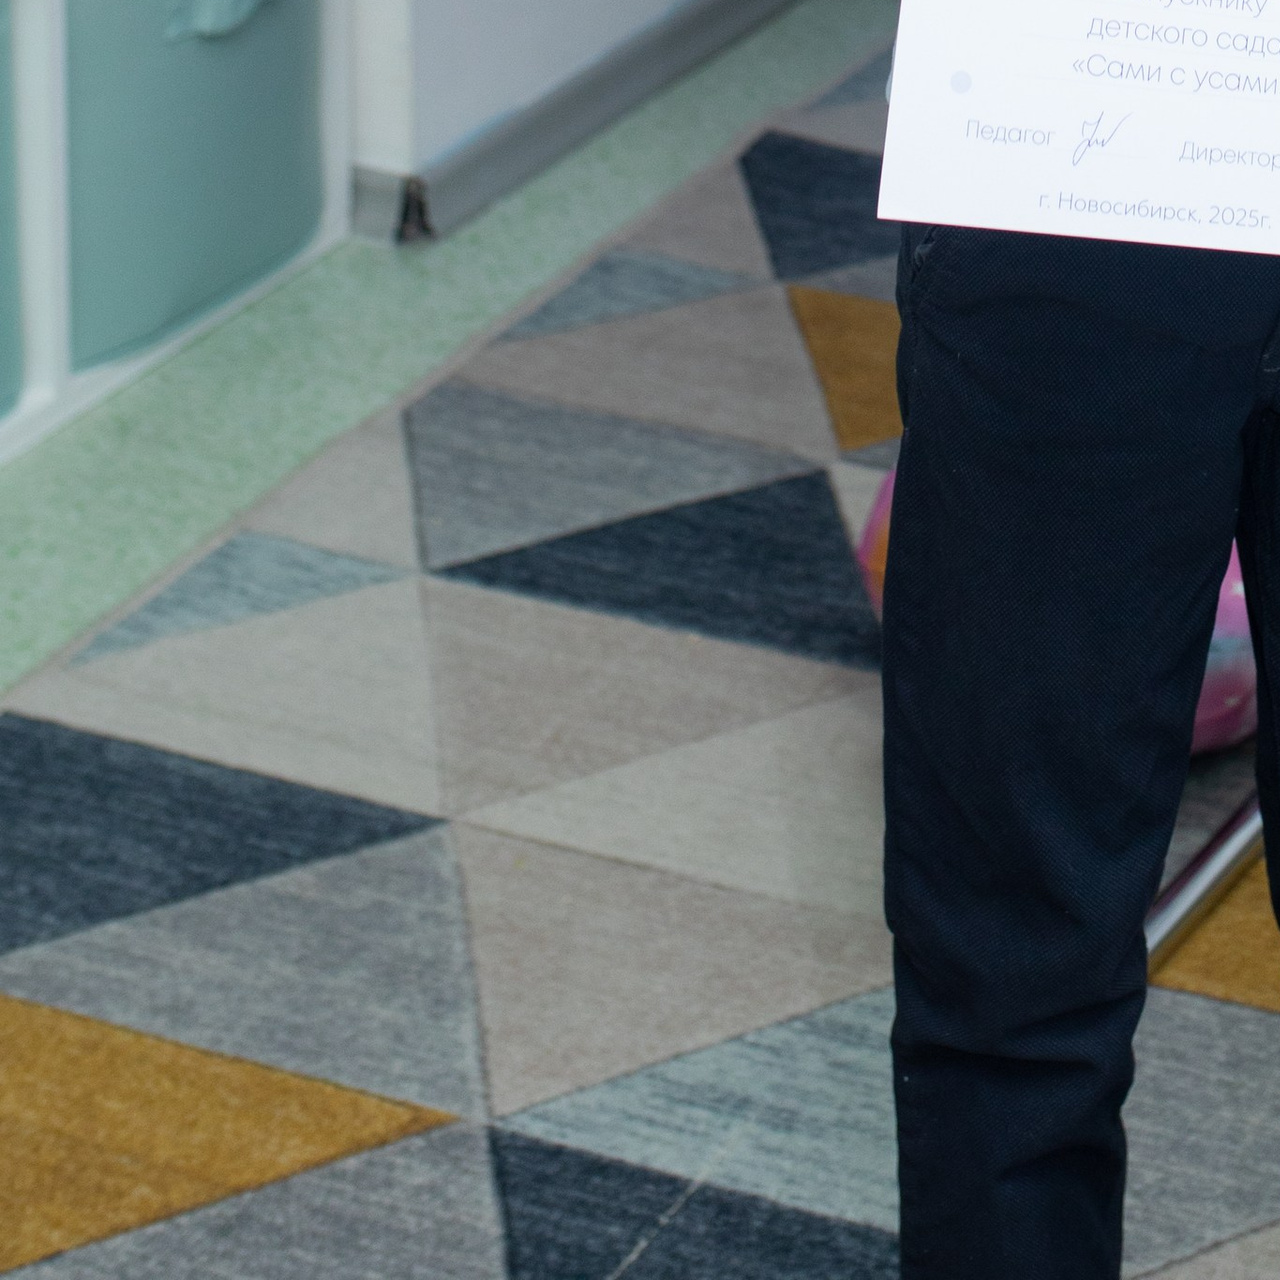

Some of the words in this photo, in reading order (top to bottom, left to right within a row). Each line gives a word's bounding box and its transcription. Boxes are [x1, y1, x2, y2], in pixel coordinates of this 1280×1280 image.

[1086, 17, 1208, 47] детского
[1072, 53, 1161, 82] «Сами
[1169, 66, 1185, 85] с
[965, 119, 1055, 145] Педагог
[1039, 194, 1052, 209] г.
[1058, 191, 1201, 223] Новосибирск,
[1208, 205, 1272, 228] 2025г.
